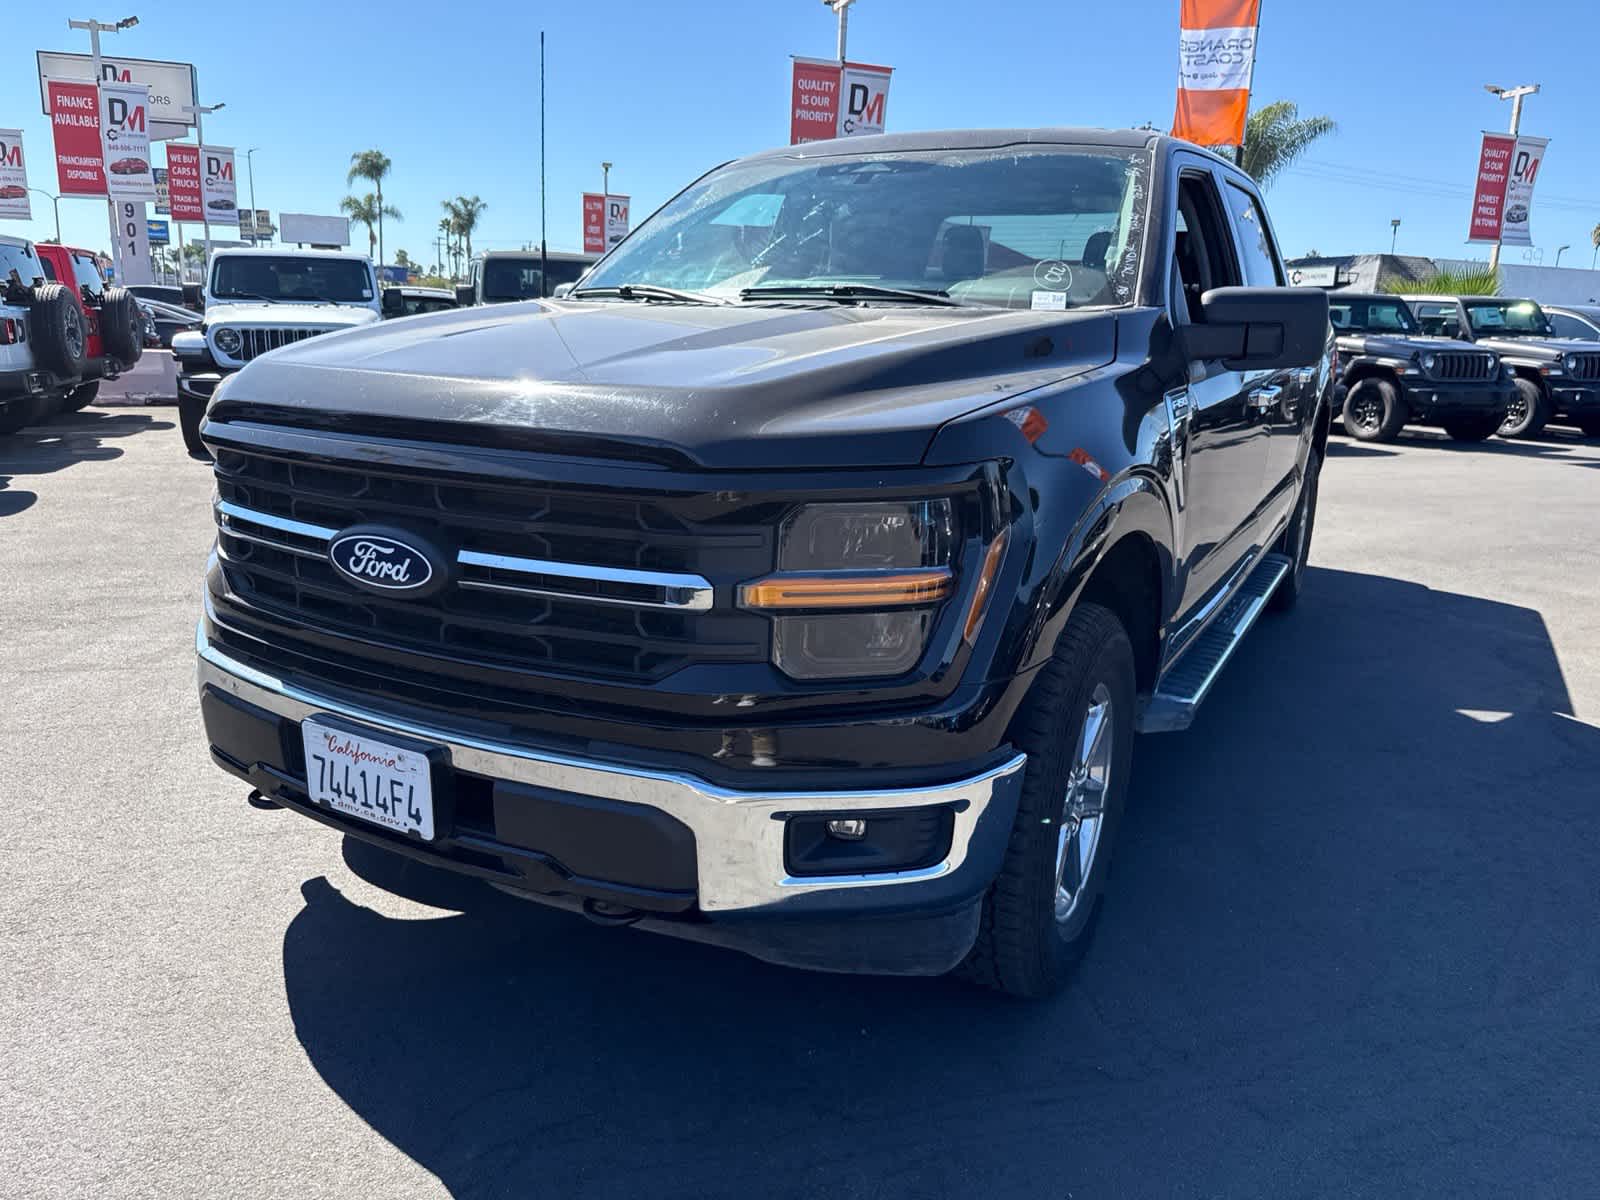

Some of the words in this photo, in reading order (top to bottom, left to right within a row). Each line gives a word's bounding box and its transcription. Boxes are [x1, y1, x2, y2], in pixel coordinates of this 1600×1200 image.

[798, 78, 836, 92] QUALITY
[56, 95, 94, 110] FINANCE
[147, 94, 171, 105] ORS
[801, 94, 809, 105] IS
[810, 95, 830, 107] OUR
[54, 113, 99, 128] AVAILABLE
[795, 108, 834, 123] PRIORITY
[170, 153, 182, 163] WE
[183, 154, 198, 165] BUY
[1484, 148, 1509, 159] QUALITY
[171, 166, 191, 176] CARS
[191, 167, 198, 177] &
[1491, 161, 1504, 171] OUR
[172, 178, 200, 189] TRUCKS
[349, 541, 411, 582] Ford
[327, 735, 406, 772] California
[312, 754, 423, 826] 74414F4
[338, 800, 401, 827] dmv.ca.gov
